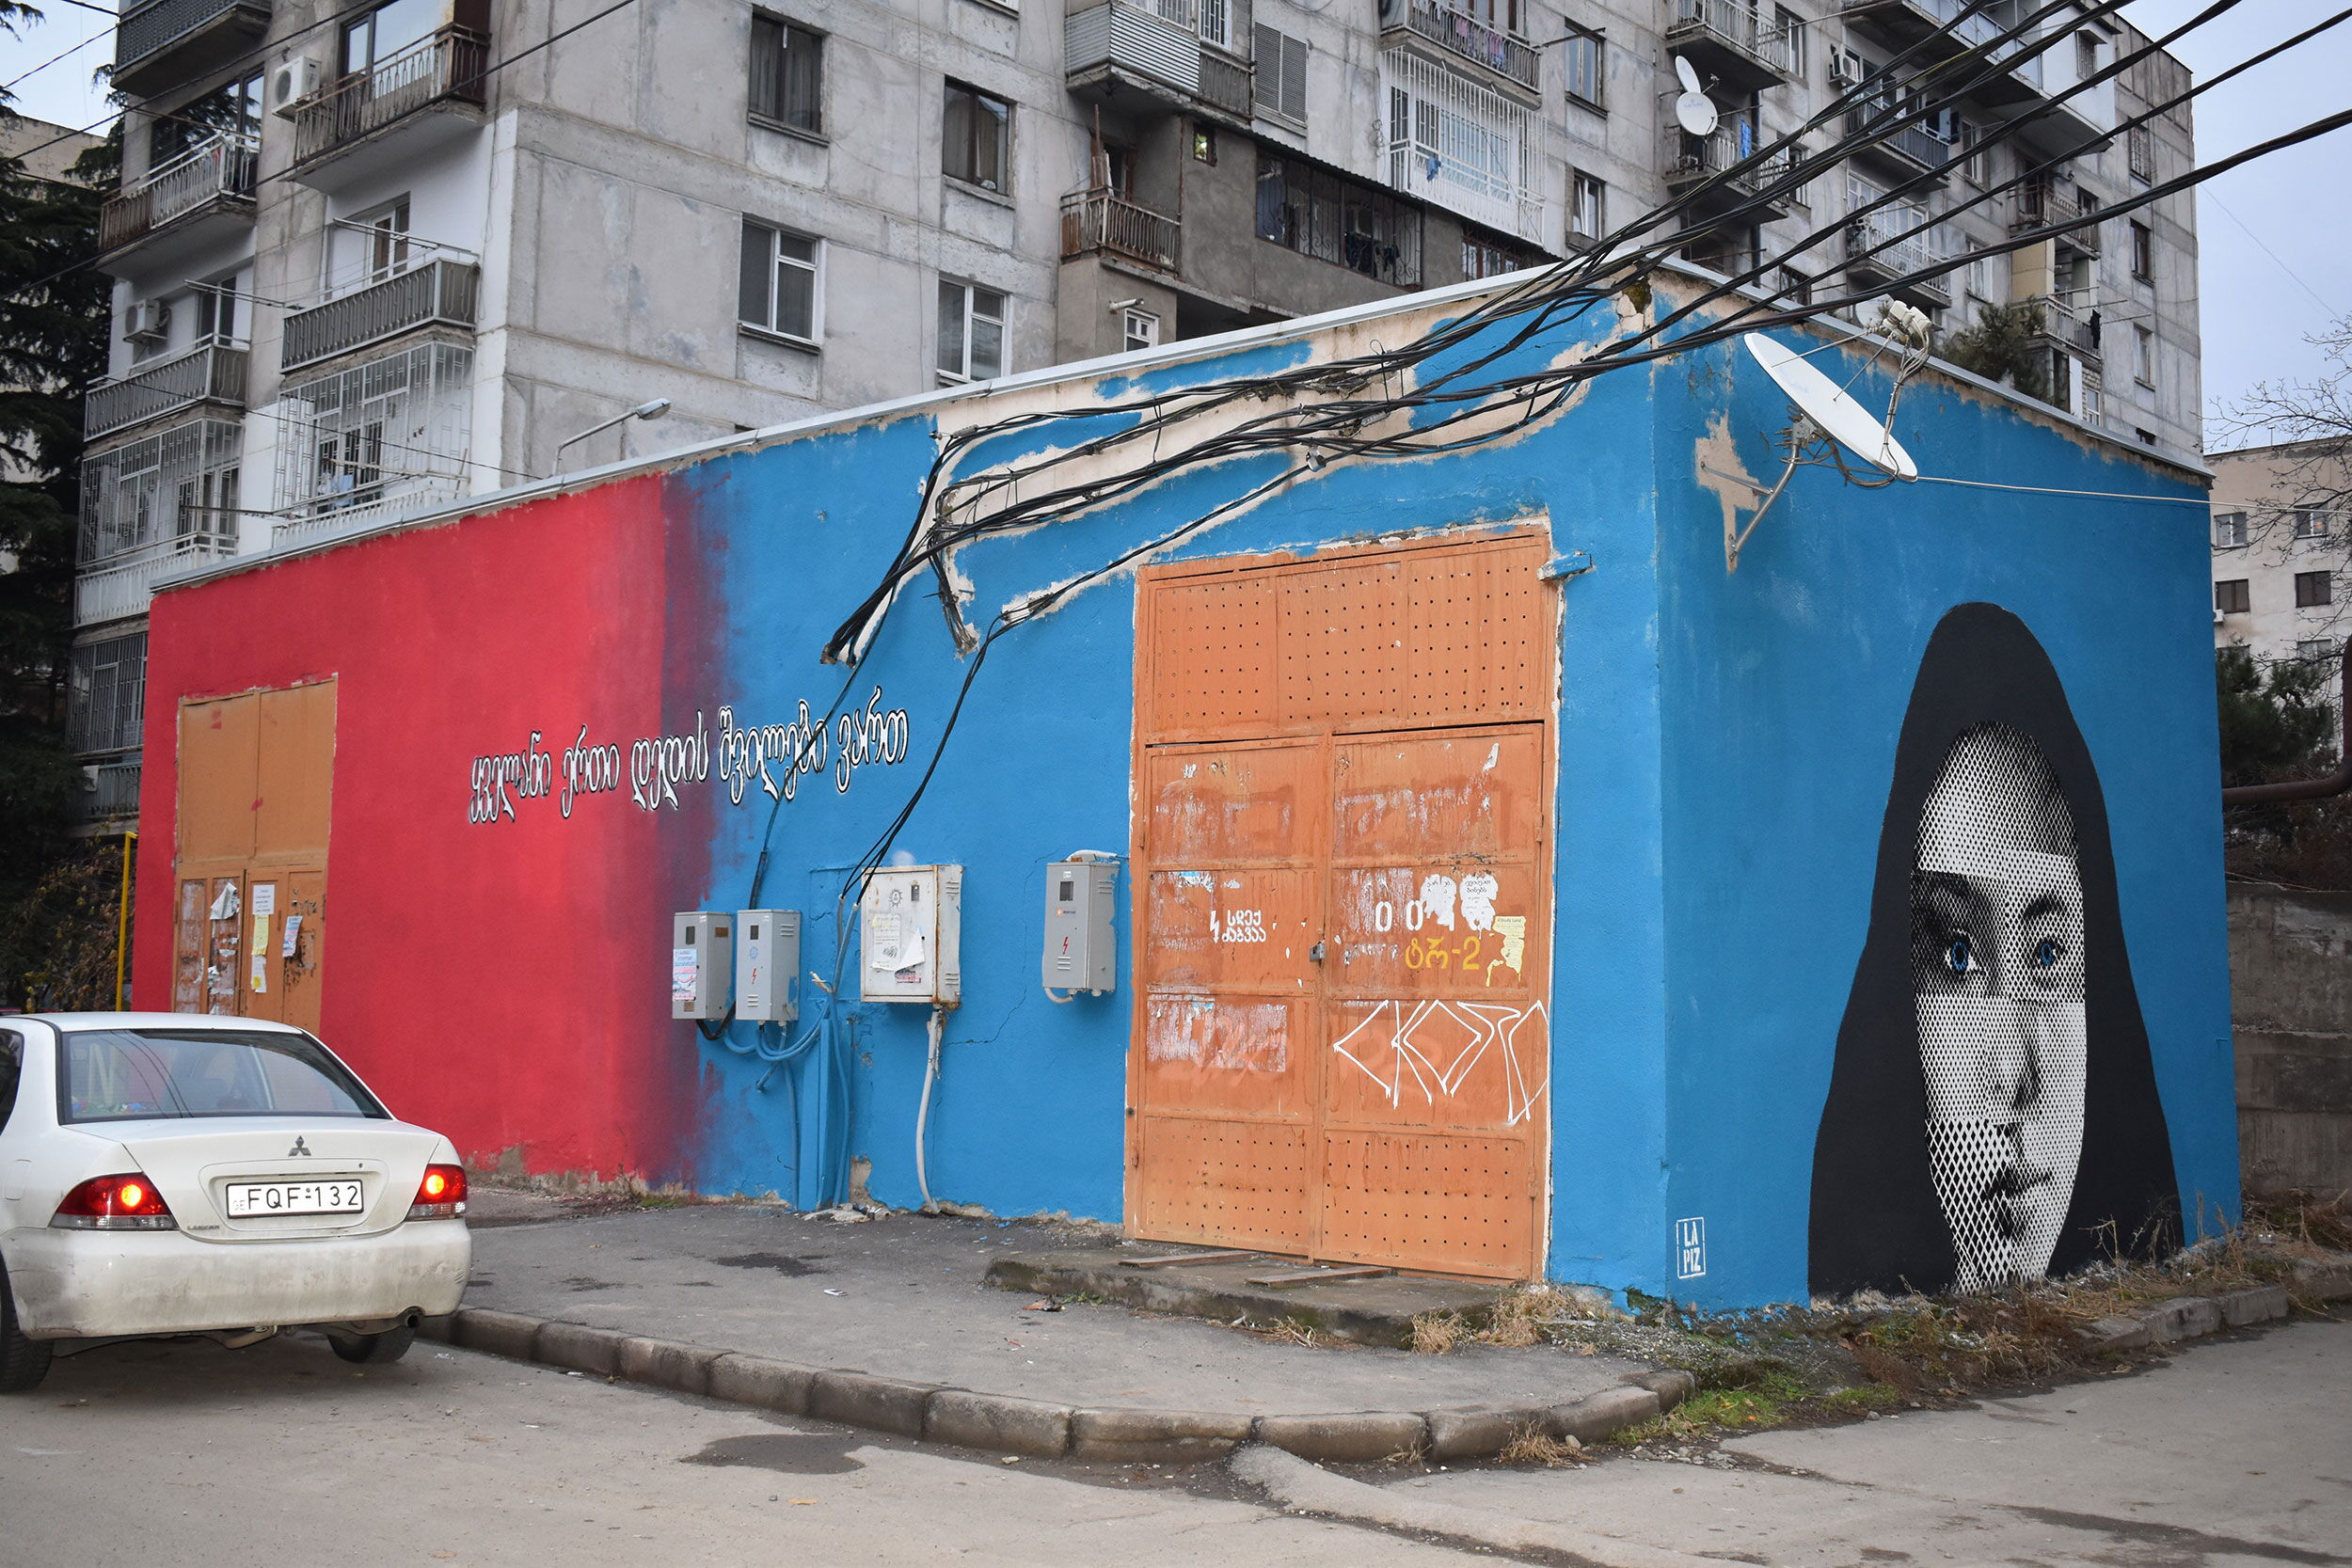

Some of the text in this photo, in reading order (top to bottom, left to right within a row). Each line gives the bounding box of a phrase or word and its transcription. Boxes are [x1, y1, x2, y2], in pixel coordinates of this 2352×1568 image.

[469, 685, 909, 823] ყველანი ერთი დედის შვილები ვართ
[247, 1184, 358, 1211] FQF-132
[1683, 1221, 1699, 1247] LA
